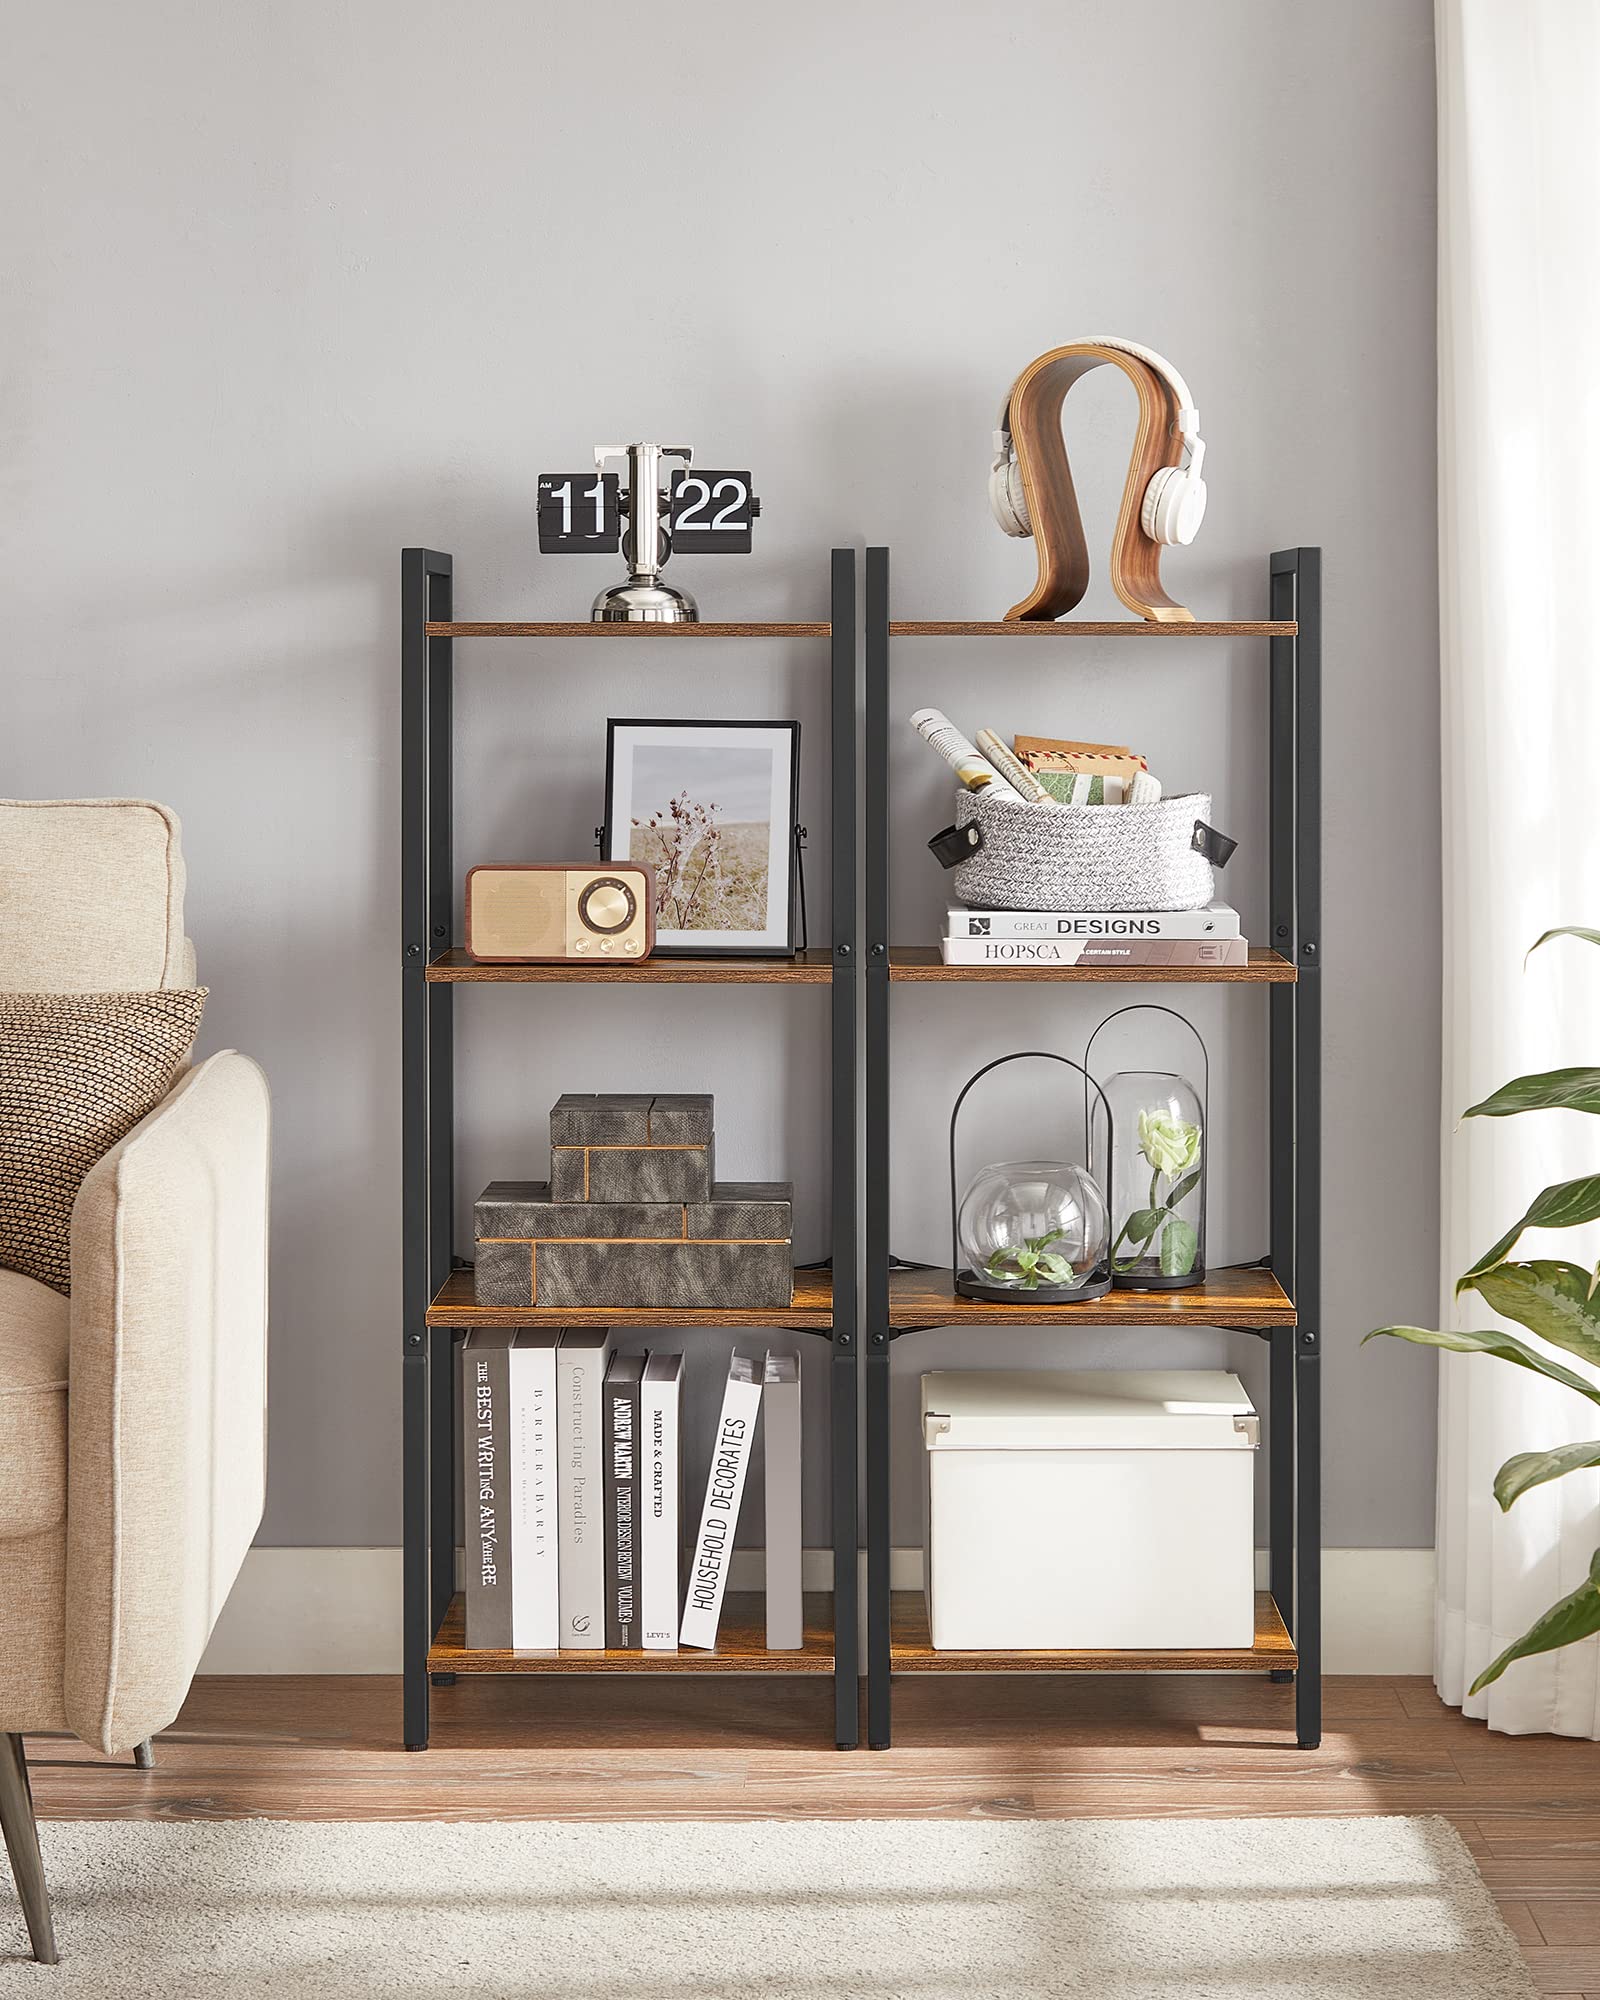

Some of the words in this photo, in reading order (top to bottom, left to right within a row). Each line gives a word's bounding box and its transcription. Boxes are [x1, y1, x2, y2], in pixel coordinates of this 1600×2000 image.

[551, 481, 604, 533] 11
[675, 478, 748, 531] 22
[1014, 922, 1049, 931] GREAT
[1057, 919, 1161, 935] DESIGNS
[985, 944, 1062, 960] HOPSCA
[477, 1361, 488, 1383] THE
[477, 1385, 493, 1431] BEST
[571, 1366, 586, 1468] Constructing
[613, 1397, 633, 1440] ANDREW
[653, 1410, 663, 1447] MADE
[614, 1441, 634, 1480] MARTIN
[653, 1449, 663, 1458] &
[616, 1486, 632, 1523] INTERIOR
[653, 1461, 663, 1518] CRAFTED
[573, 1476, 587, 1544] Paradies
[692, 1518, 728, 1611] HOUSEHOLD
[710, 1417, 746, 1511] DECORATES
[617, 1523, 632, 1551] DESIGN
[617, 1551, 633, 1581] REVIEW
